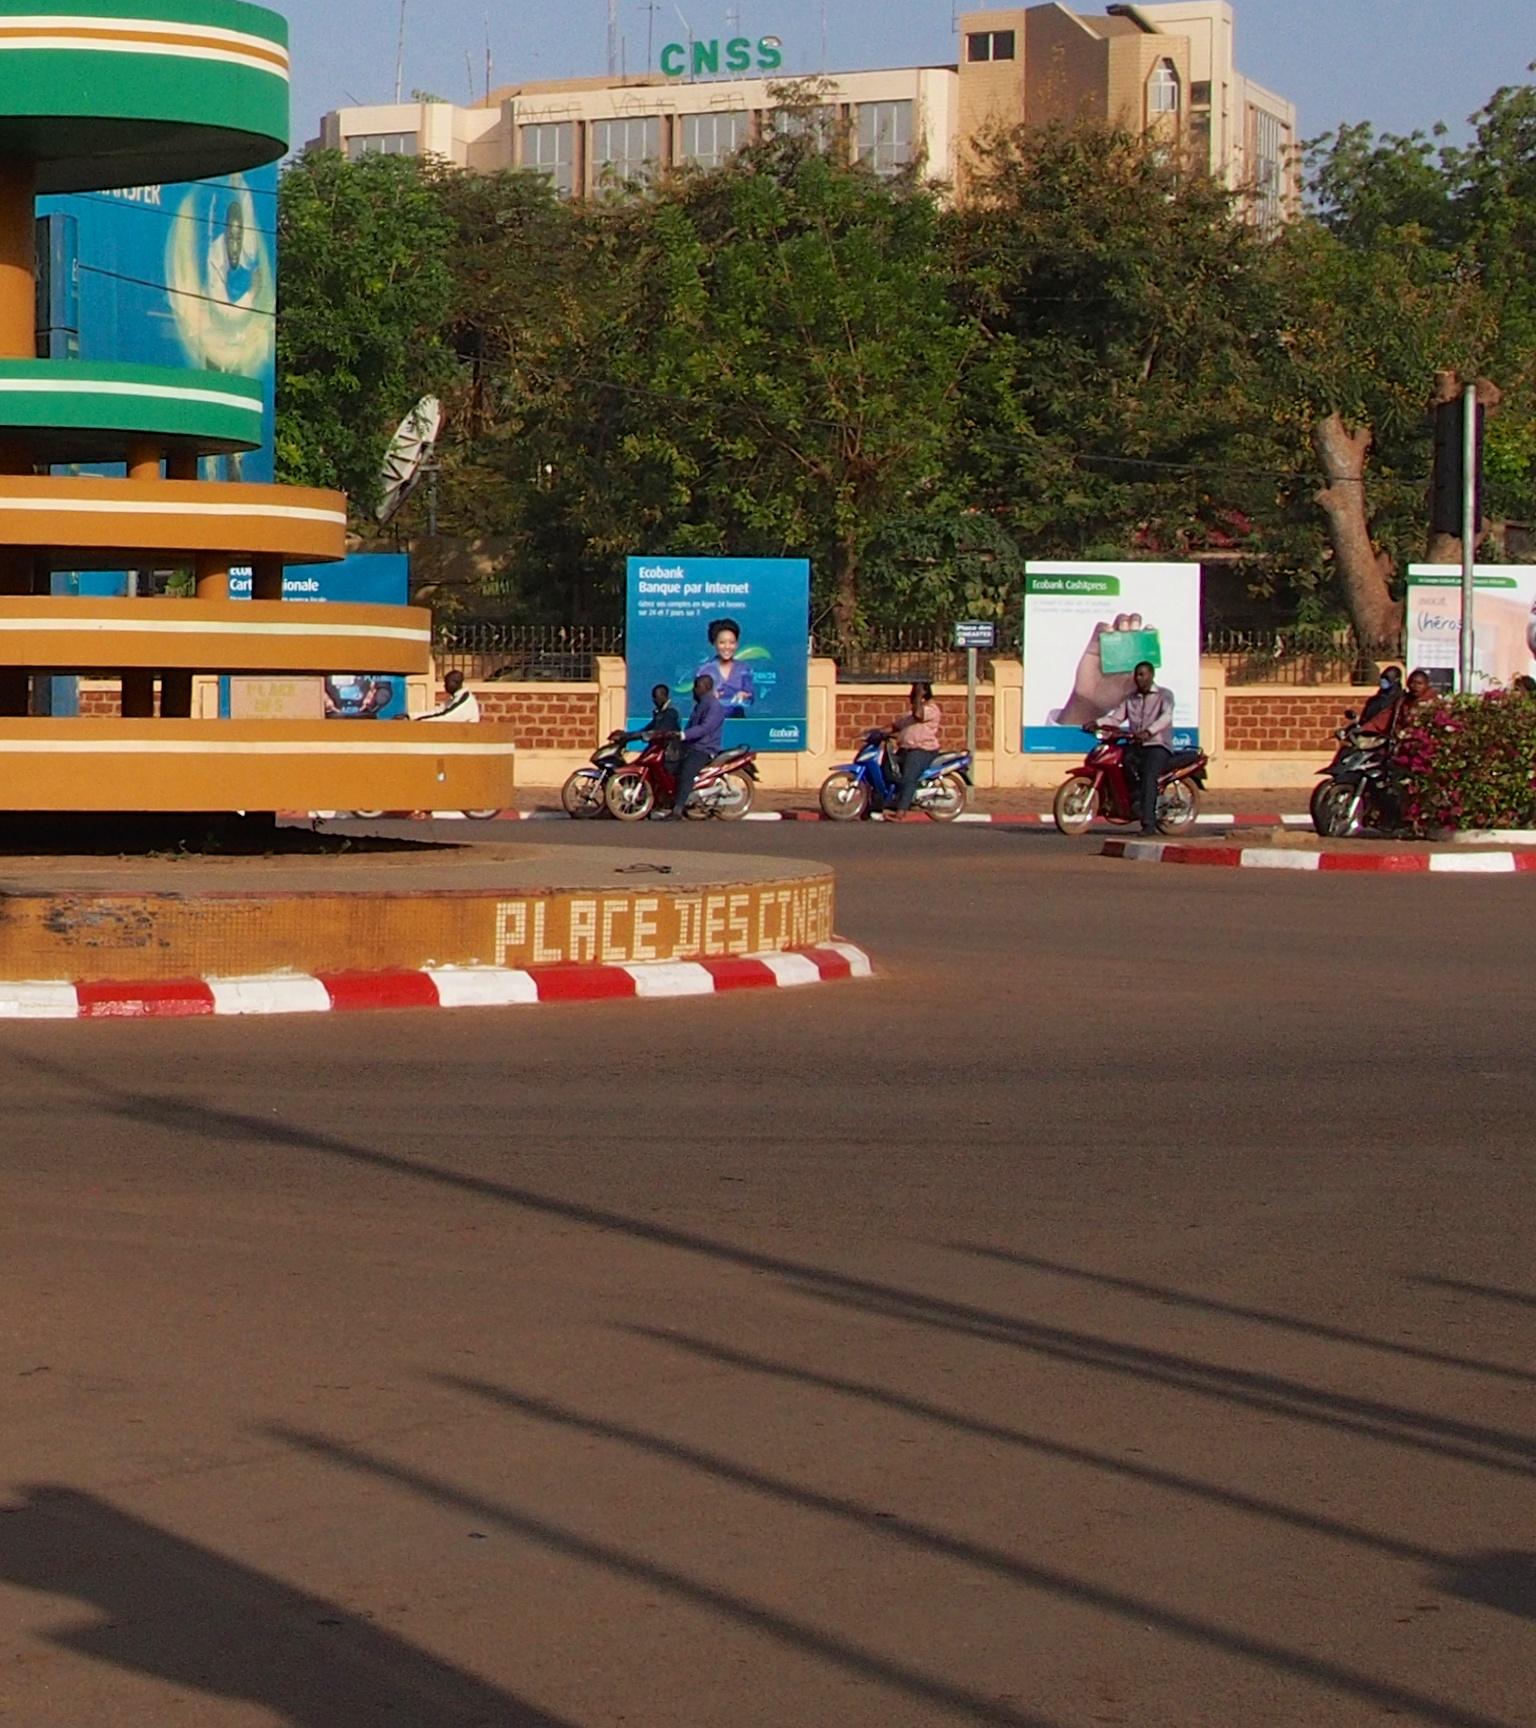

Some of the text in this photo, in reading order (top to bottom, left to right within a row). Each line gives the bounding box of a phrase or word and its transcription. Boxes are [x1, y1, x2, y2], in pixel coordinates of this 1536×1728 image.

[660, 35, 782, 77] CNSS
[639, 566, 684, 579] Ecobank
[229, 578, 320, 592] Cart ionale
[639, 582, 749, 595] Banque par Internet
[1033, 580, 1063, 590] Ecobank
[769, 726, 799, 738] Ecobank
[495, 898, 658, 966] PLACE
[672, 894, 749, 957] DES
